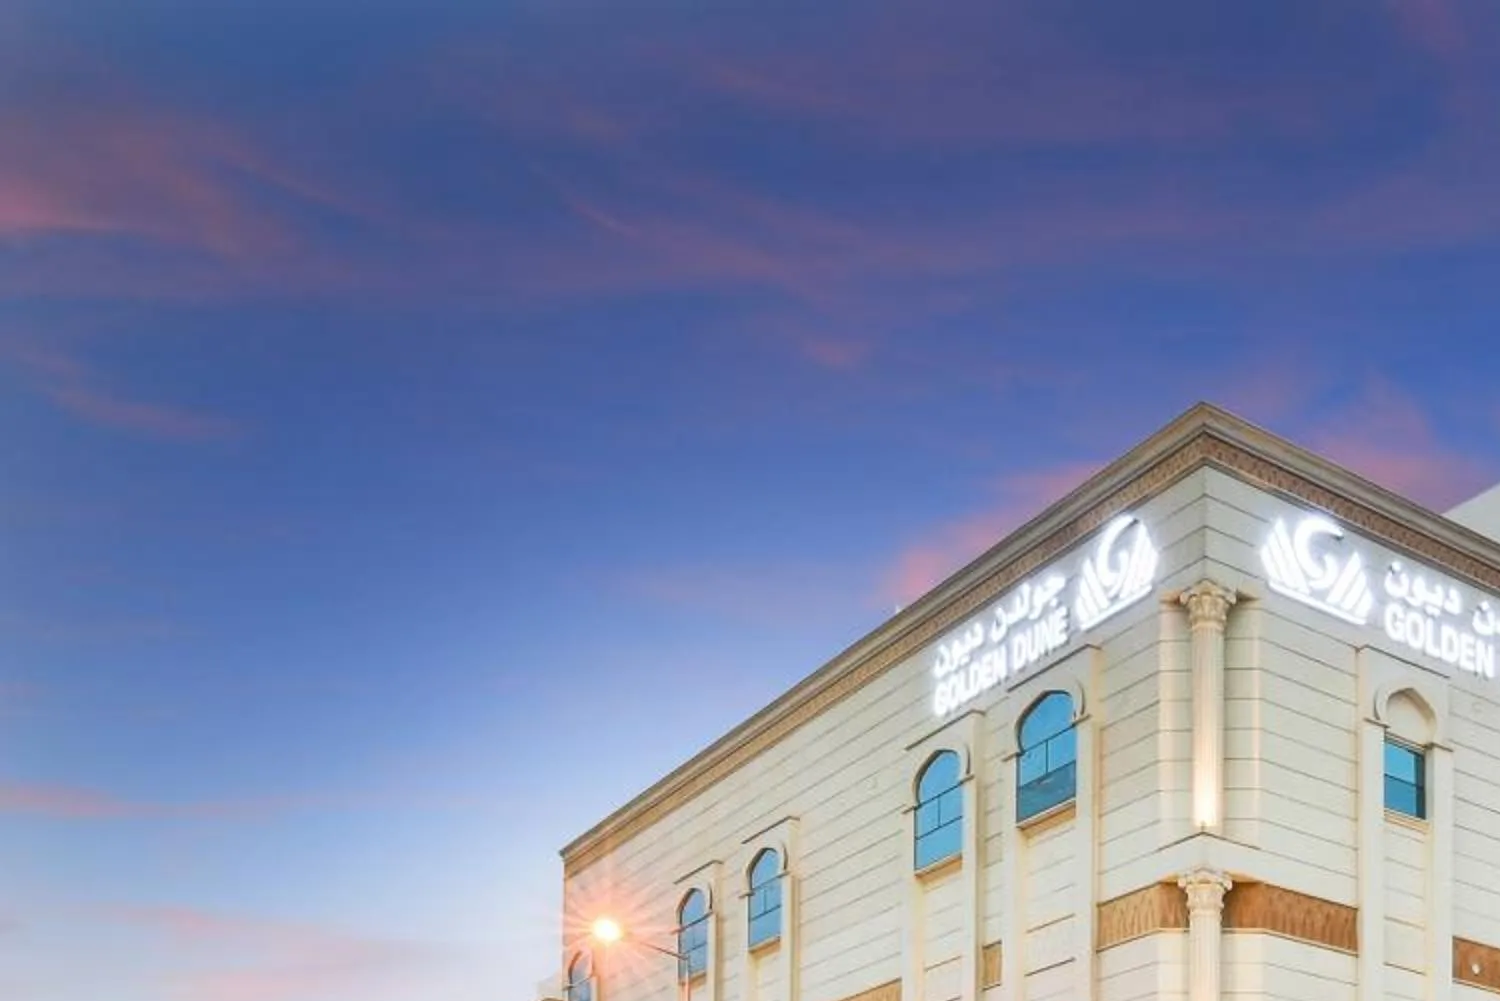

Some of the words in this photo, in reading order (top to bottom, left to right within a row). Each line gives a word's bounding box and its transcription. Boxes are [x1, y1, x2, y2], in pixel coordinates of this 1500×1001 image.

[934, 645, 1007, 717] GOLDEN
[1012, 606, 1067, 671] DUNE
[1384, 602, 1495, 678] GOLDEN
